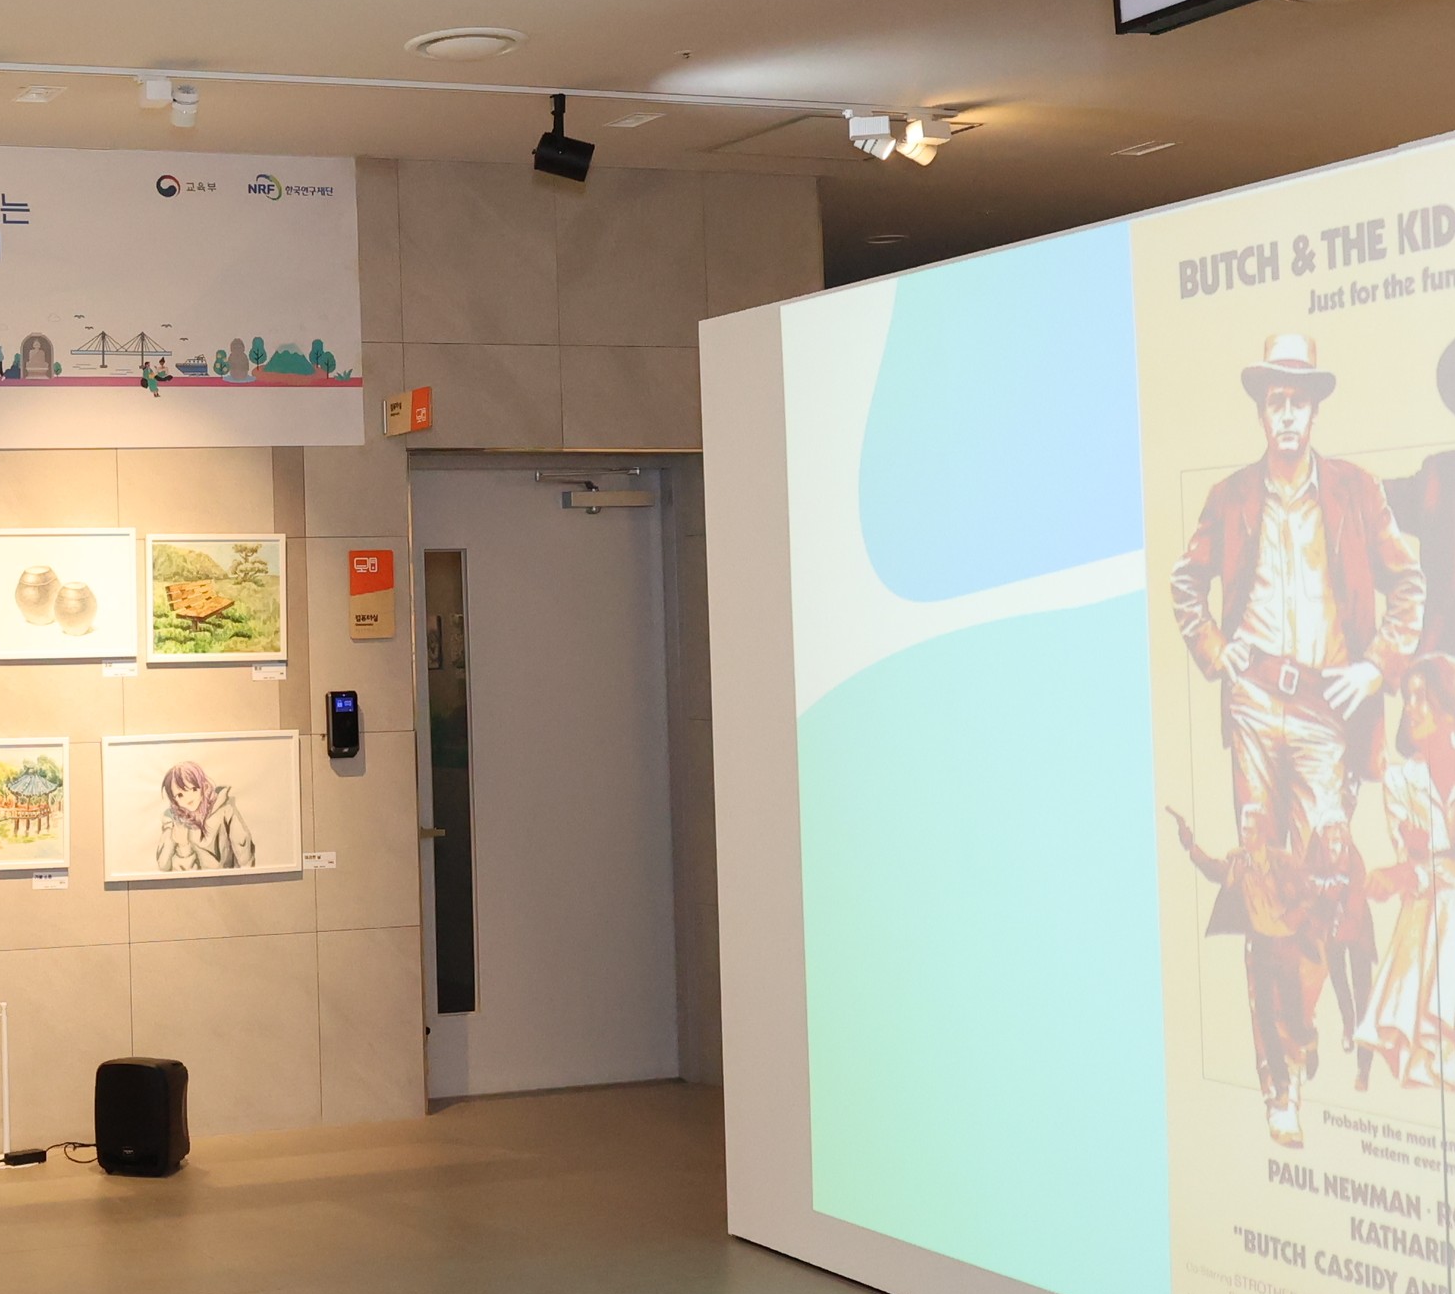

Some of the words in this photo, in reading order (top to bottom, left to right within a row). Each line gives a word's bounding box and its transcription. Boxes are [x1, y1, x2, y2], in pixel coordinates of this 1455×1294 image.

[186, 182, 216, 192] 교육부
[248, 184, 275, 194] NRF
[285, 186, 334, 197] 한국연구재단
[1178, 241, 1280, 299] BUTCH
[1291, 234, 1317, 277] &
[1320, 219, 1388, 271] THE
[1308, 288, 1345, 315] Just
[1349, 278, 1379, 306] for
[1383, 273, 1415, 301] the
[1323, 1109, 1379, 1139] Probably
[1382, 1123, 1402, 1142] the
[1406, 1132, 1437, 1149] most
[1361, 1139, 1410, 1165] Western
[1414, 1154, 1441, 1172] ever
[1267, 1158, 1320, 1195] PAUL
[1324, 1172, 1422, 1221] NEWMAN
[1233, 1225, 1307, 1270] "BUTCH
[1314, 1250, 1398, 1294] CASSIDY
